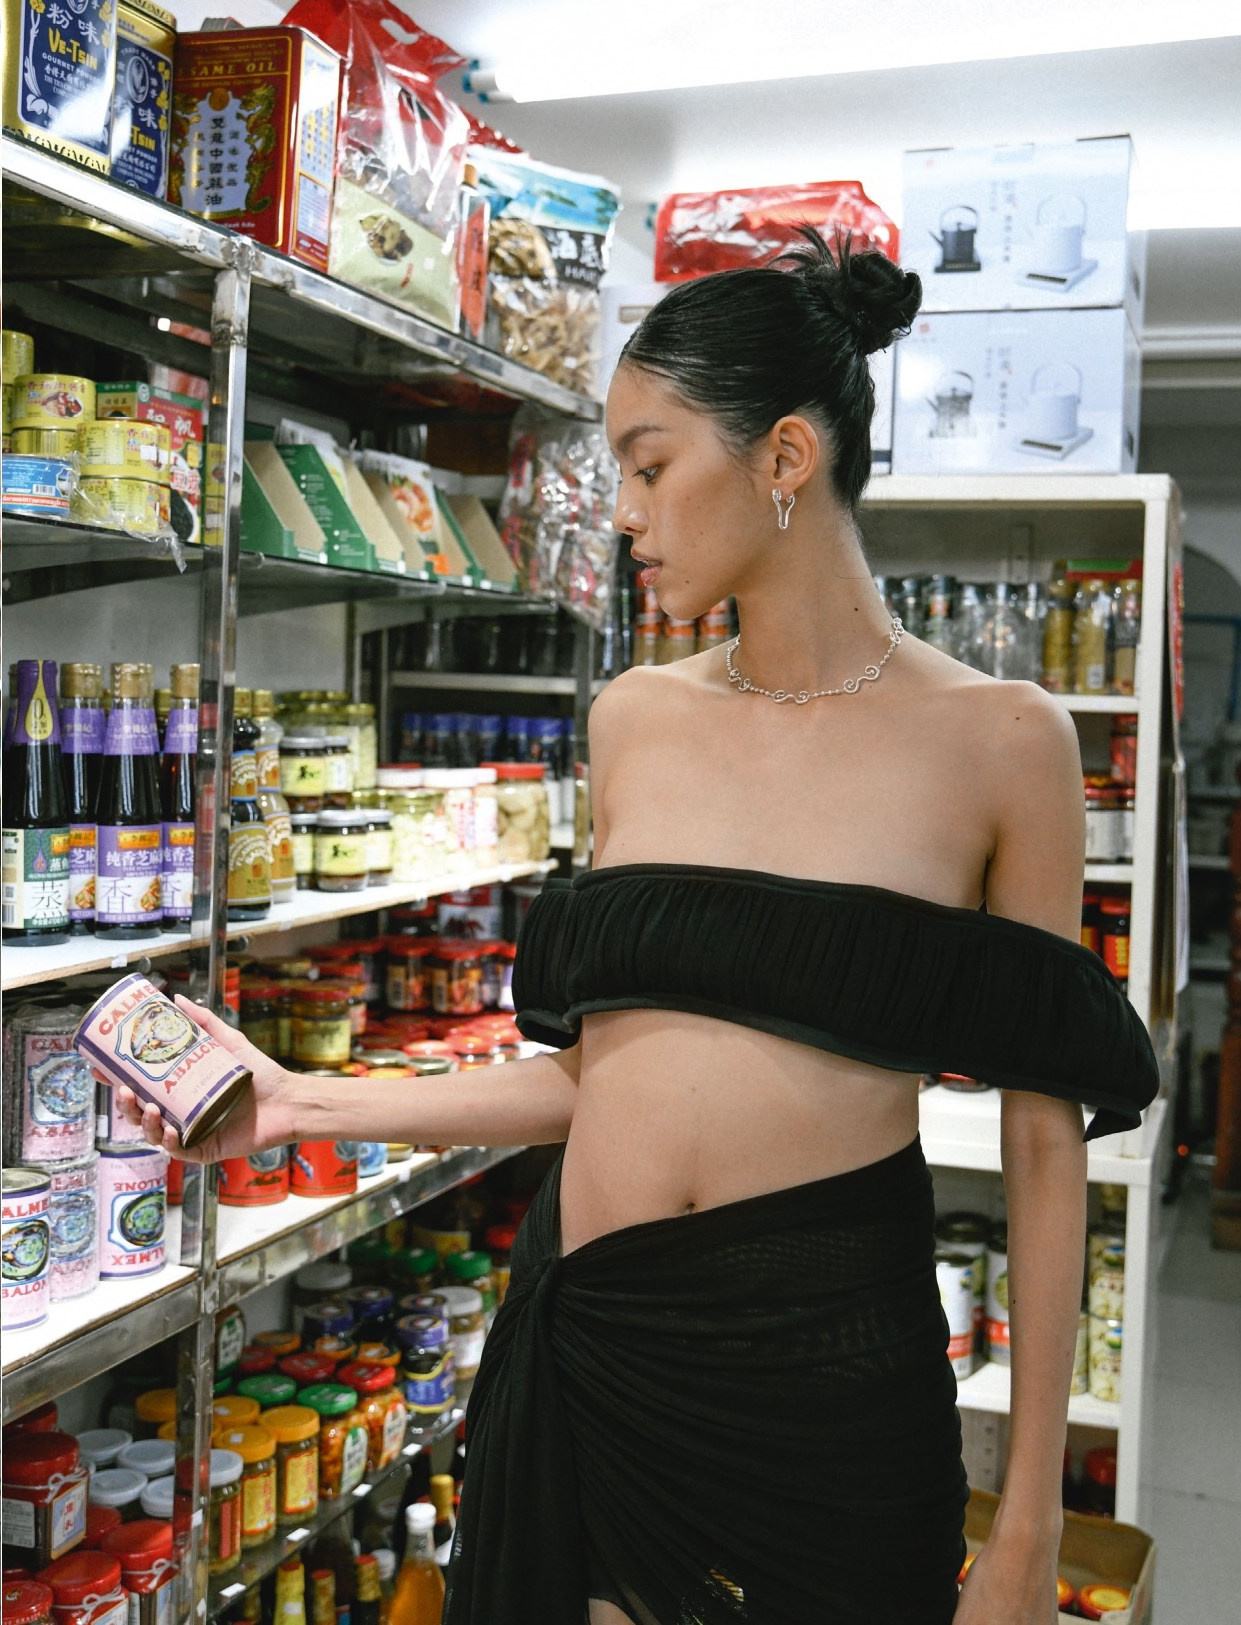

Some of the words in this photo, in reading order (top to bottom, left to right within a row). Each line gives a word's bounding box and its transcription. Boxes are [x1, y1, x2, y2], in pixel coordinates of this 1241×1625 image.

[41, 52, 75, 72] GOURMET
[246, 62, 276, 73] OIL
[164, 1039, 221, 1094] ABALON
[2, 1197, 49, 1219] ALME
